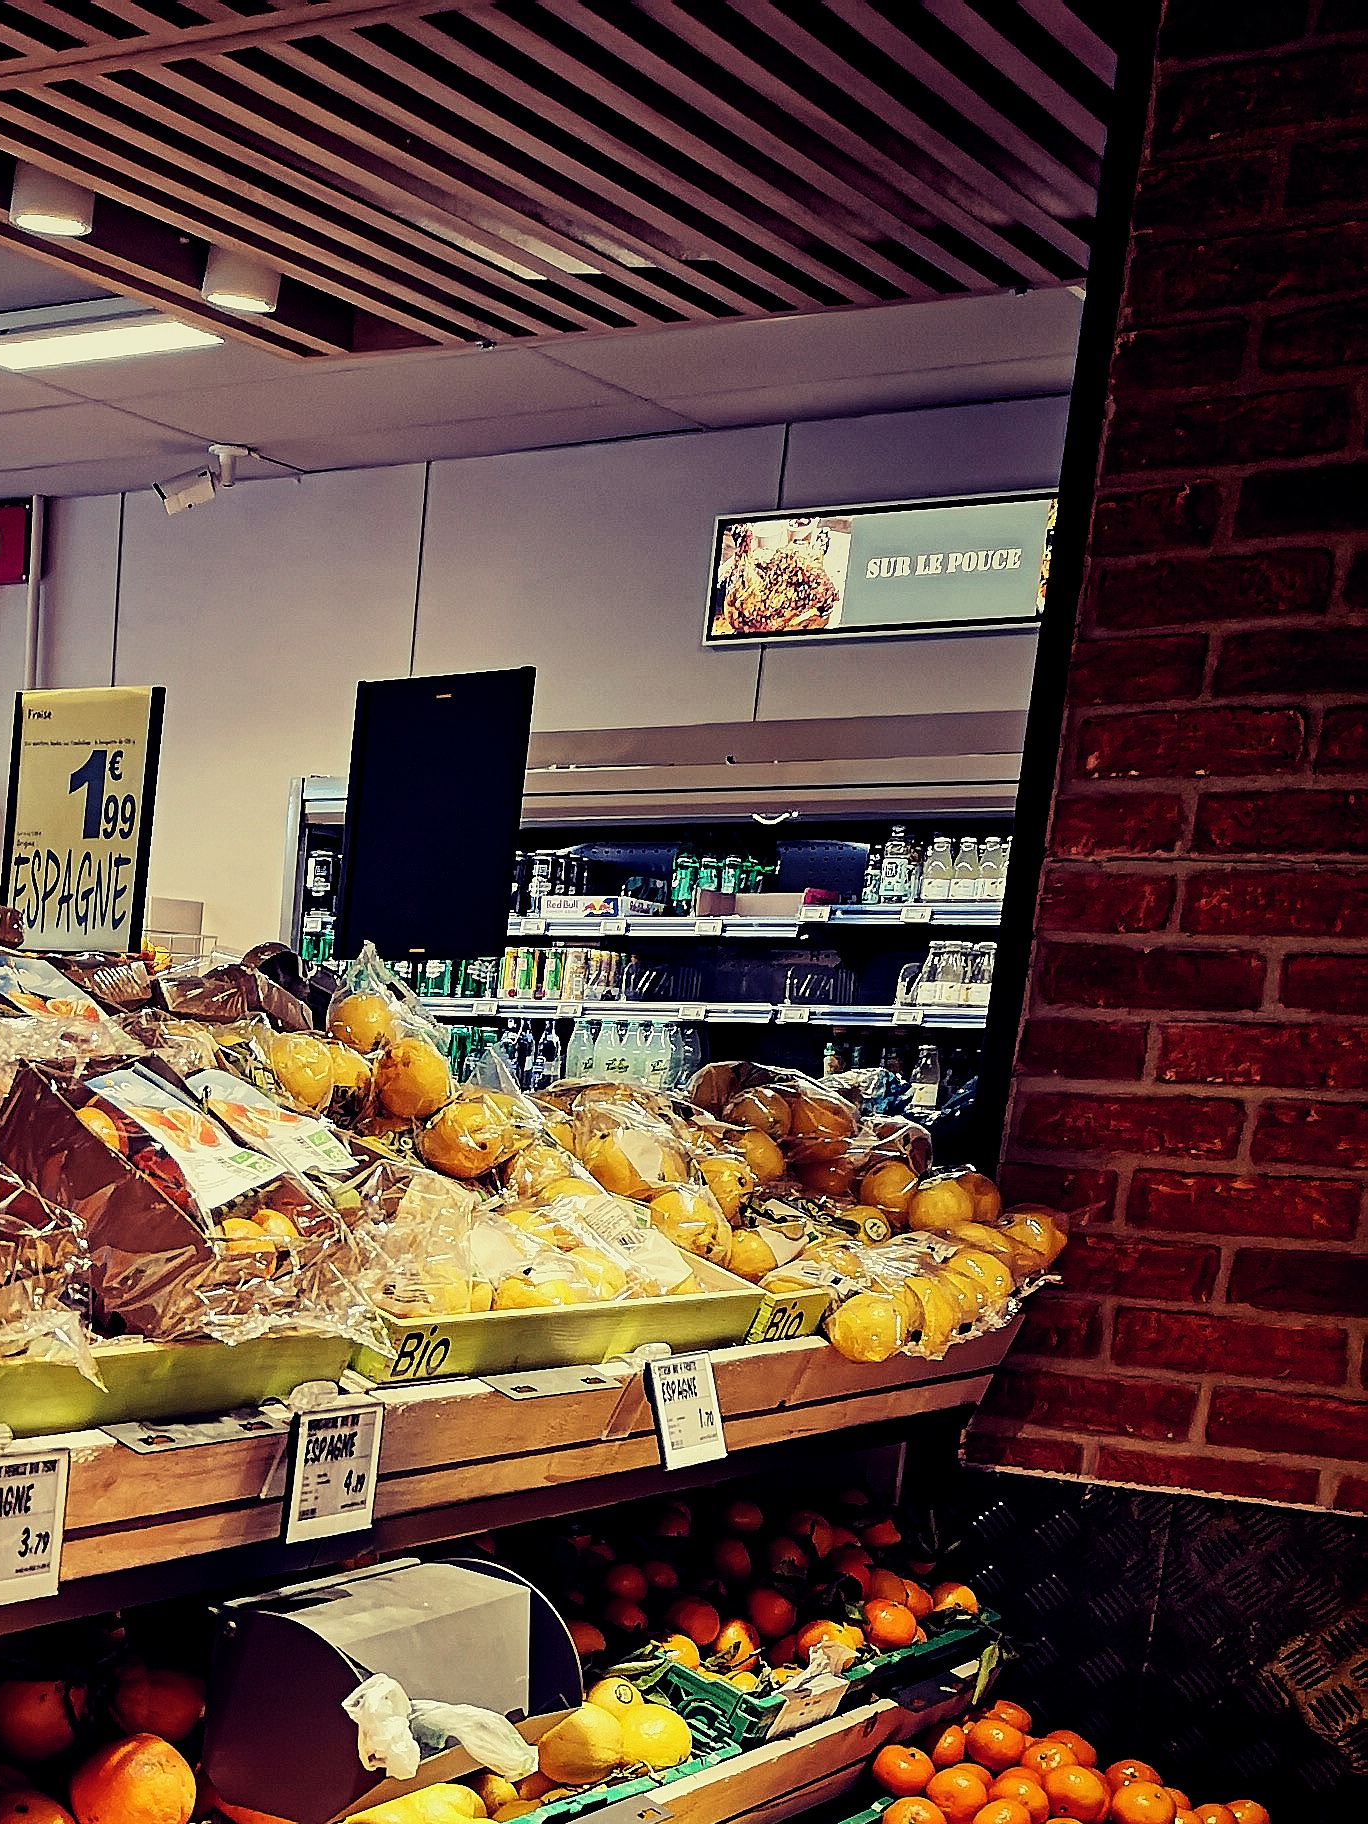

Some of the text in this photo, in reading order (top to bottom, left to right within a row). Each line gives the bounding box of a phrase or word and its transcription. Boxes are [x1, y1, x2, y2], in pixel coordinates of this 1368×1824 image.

[865, 548, 1023, 579] SUR LE POUCE
[27, 708, 53, 721] Fraise
[12, 849, 132, 936] ESPAGNE
[763, 1300, 804, 1340] Bio
[389, 1325, 450, 1378] Bio
[661, 1376, 698, 1403] ESPAGNE
[304, 1430, 358, 1465] ESPAGNE
